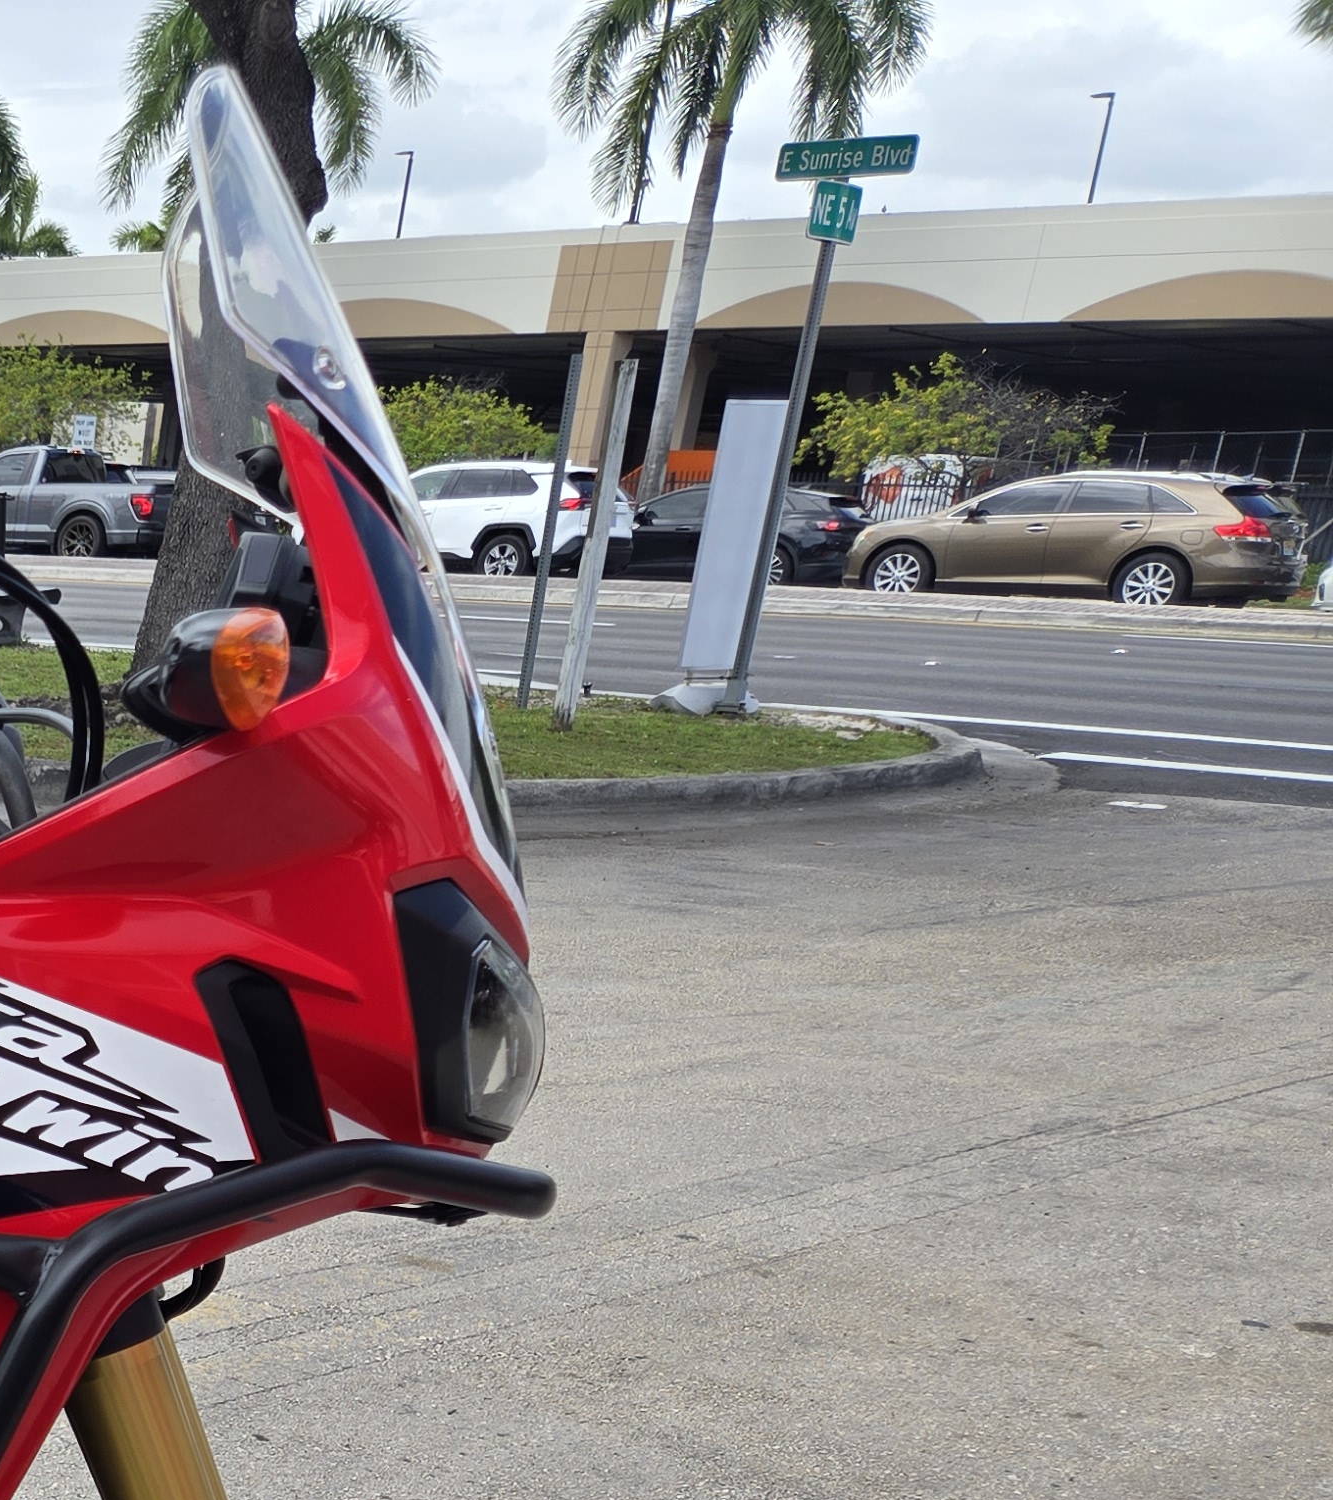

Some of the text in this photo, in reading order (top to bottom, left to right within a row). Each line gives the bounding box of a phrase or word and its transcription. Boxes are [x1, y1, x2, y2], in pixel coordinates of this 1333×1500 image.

[781, 144, 912, 172] E Sunrise Blvd
[813, 193, 835, 226] NE
[836, 196, 847, 229] 5
